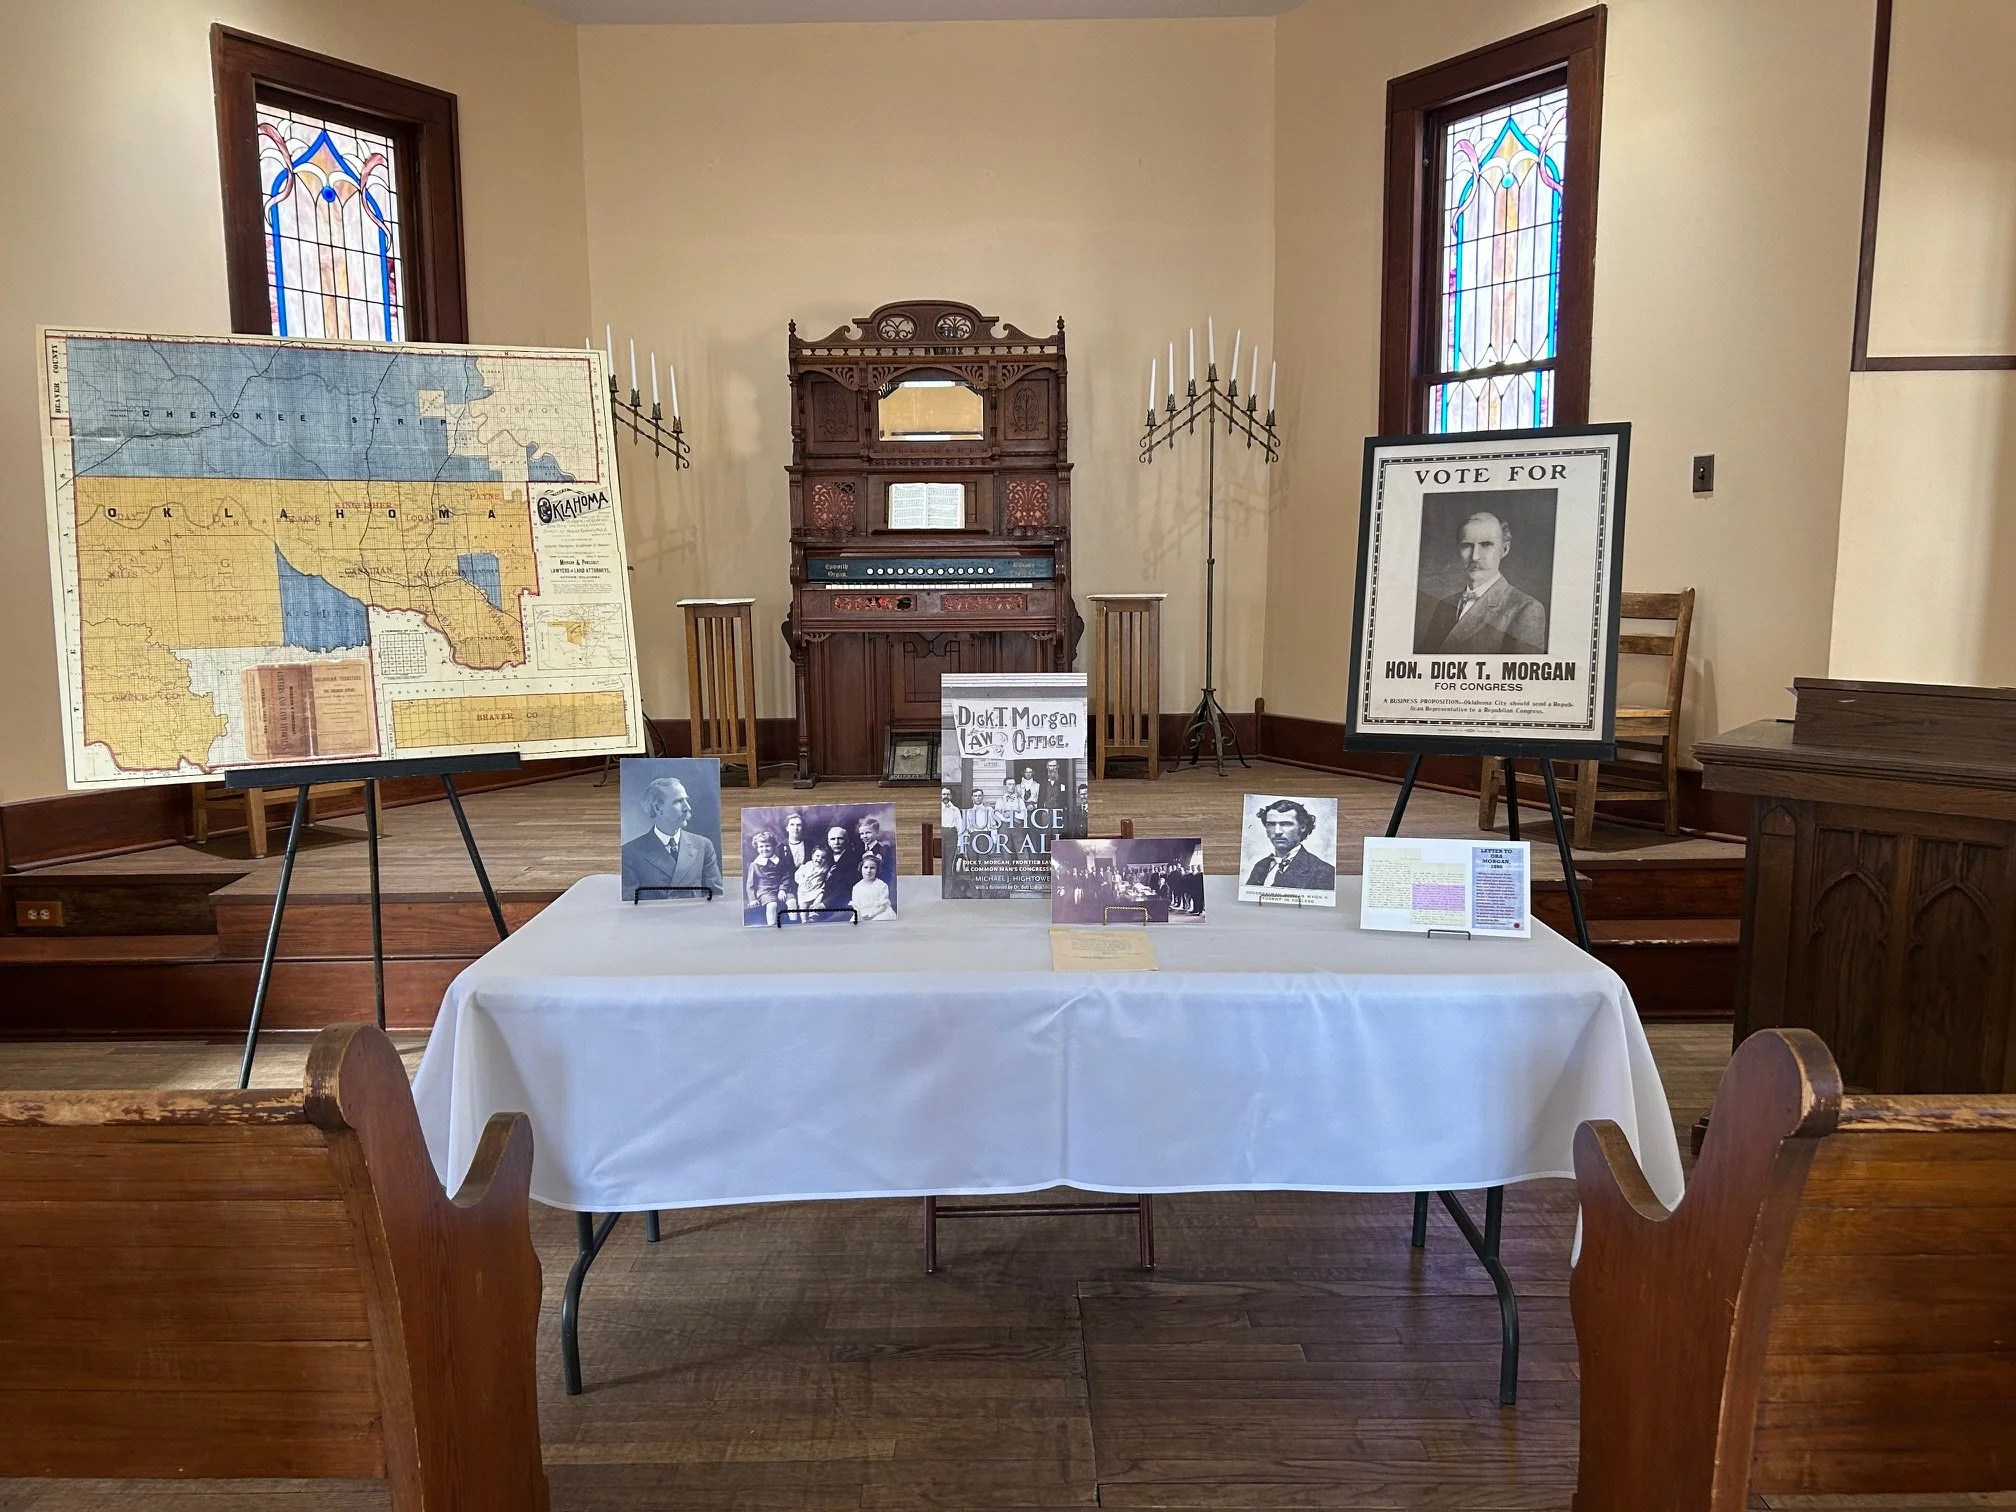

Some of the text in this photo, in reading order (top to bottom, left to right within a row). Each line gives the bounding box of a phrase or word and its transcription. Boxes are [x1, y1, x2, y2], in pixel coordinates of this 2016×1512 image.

[1415, 464, 1567, 485] VOTE FOR
[537, 491, 609, 524] OKLAHOMA
[1385, 661, 1576, 681] HON. DICK T. MORGAN
[1434, 682, 1524, 692] FOR CONGRESS
[476, 712, 514, 721] BEAVER
[1012, 706, 1078, 730] Morgan
[960, 808, 1064, 830] JUSTICE
[958, 833, 1012, 854] FOR
